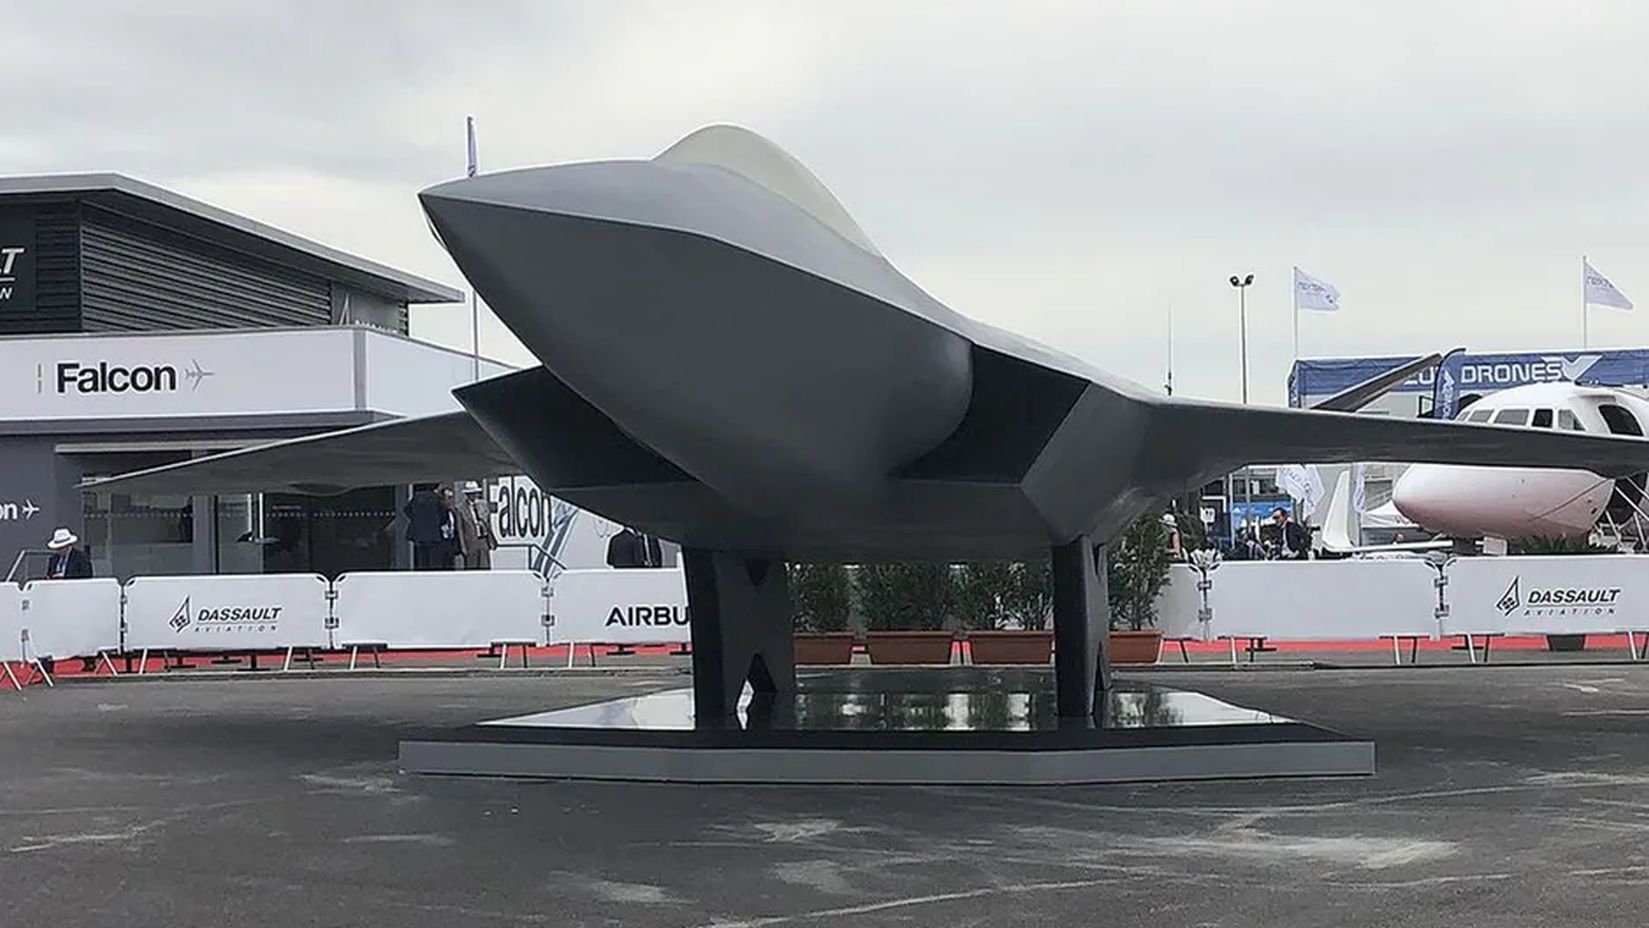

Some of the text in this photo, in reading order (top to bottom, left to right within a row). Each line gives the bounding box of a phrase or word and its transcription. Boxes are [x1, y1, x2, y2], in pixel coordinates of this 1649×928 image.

[0, 248, 25, 274] T
[57, 362, 176, 393] Falcon
[1461, 362, 1563, 384] DRONES
[0, 503, 18, 520] n
[1527, 588, 1621, 604] DASSAULT
[197, 607, 283, 621] DASSAULT
[605, 606, 690, 627] AIRBU
[1523, 607, 1615, 616] AVIATION
